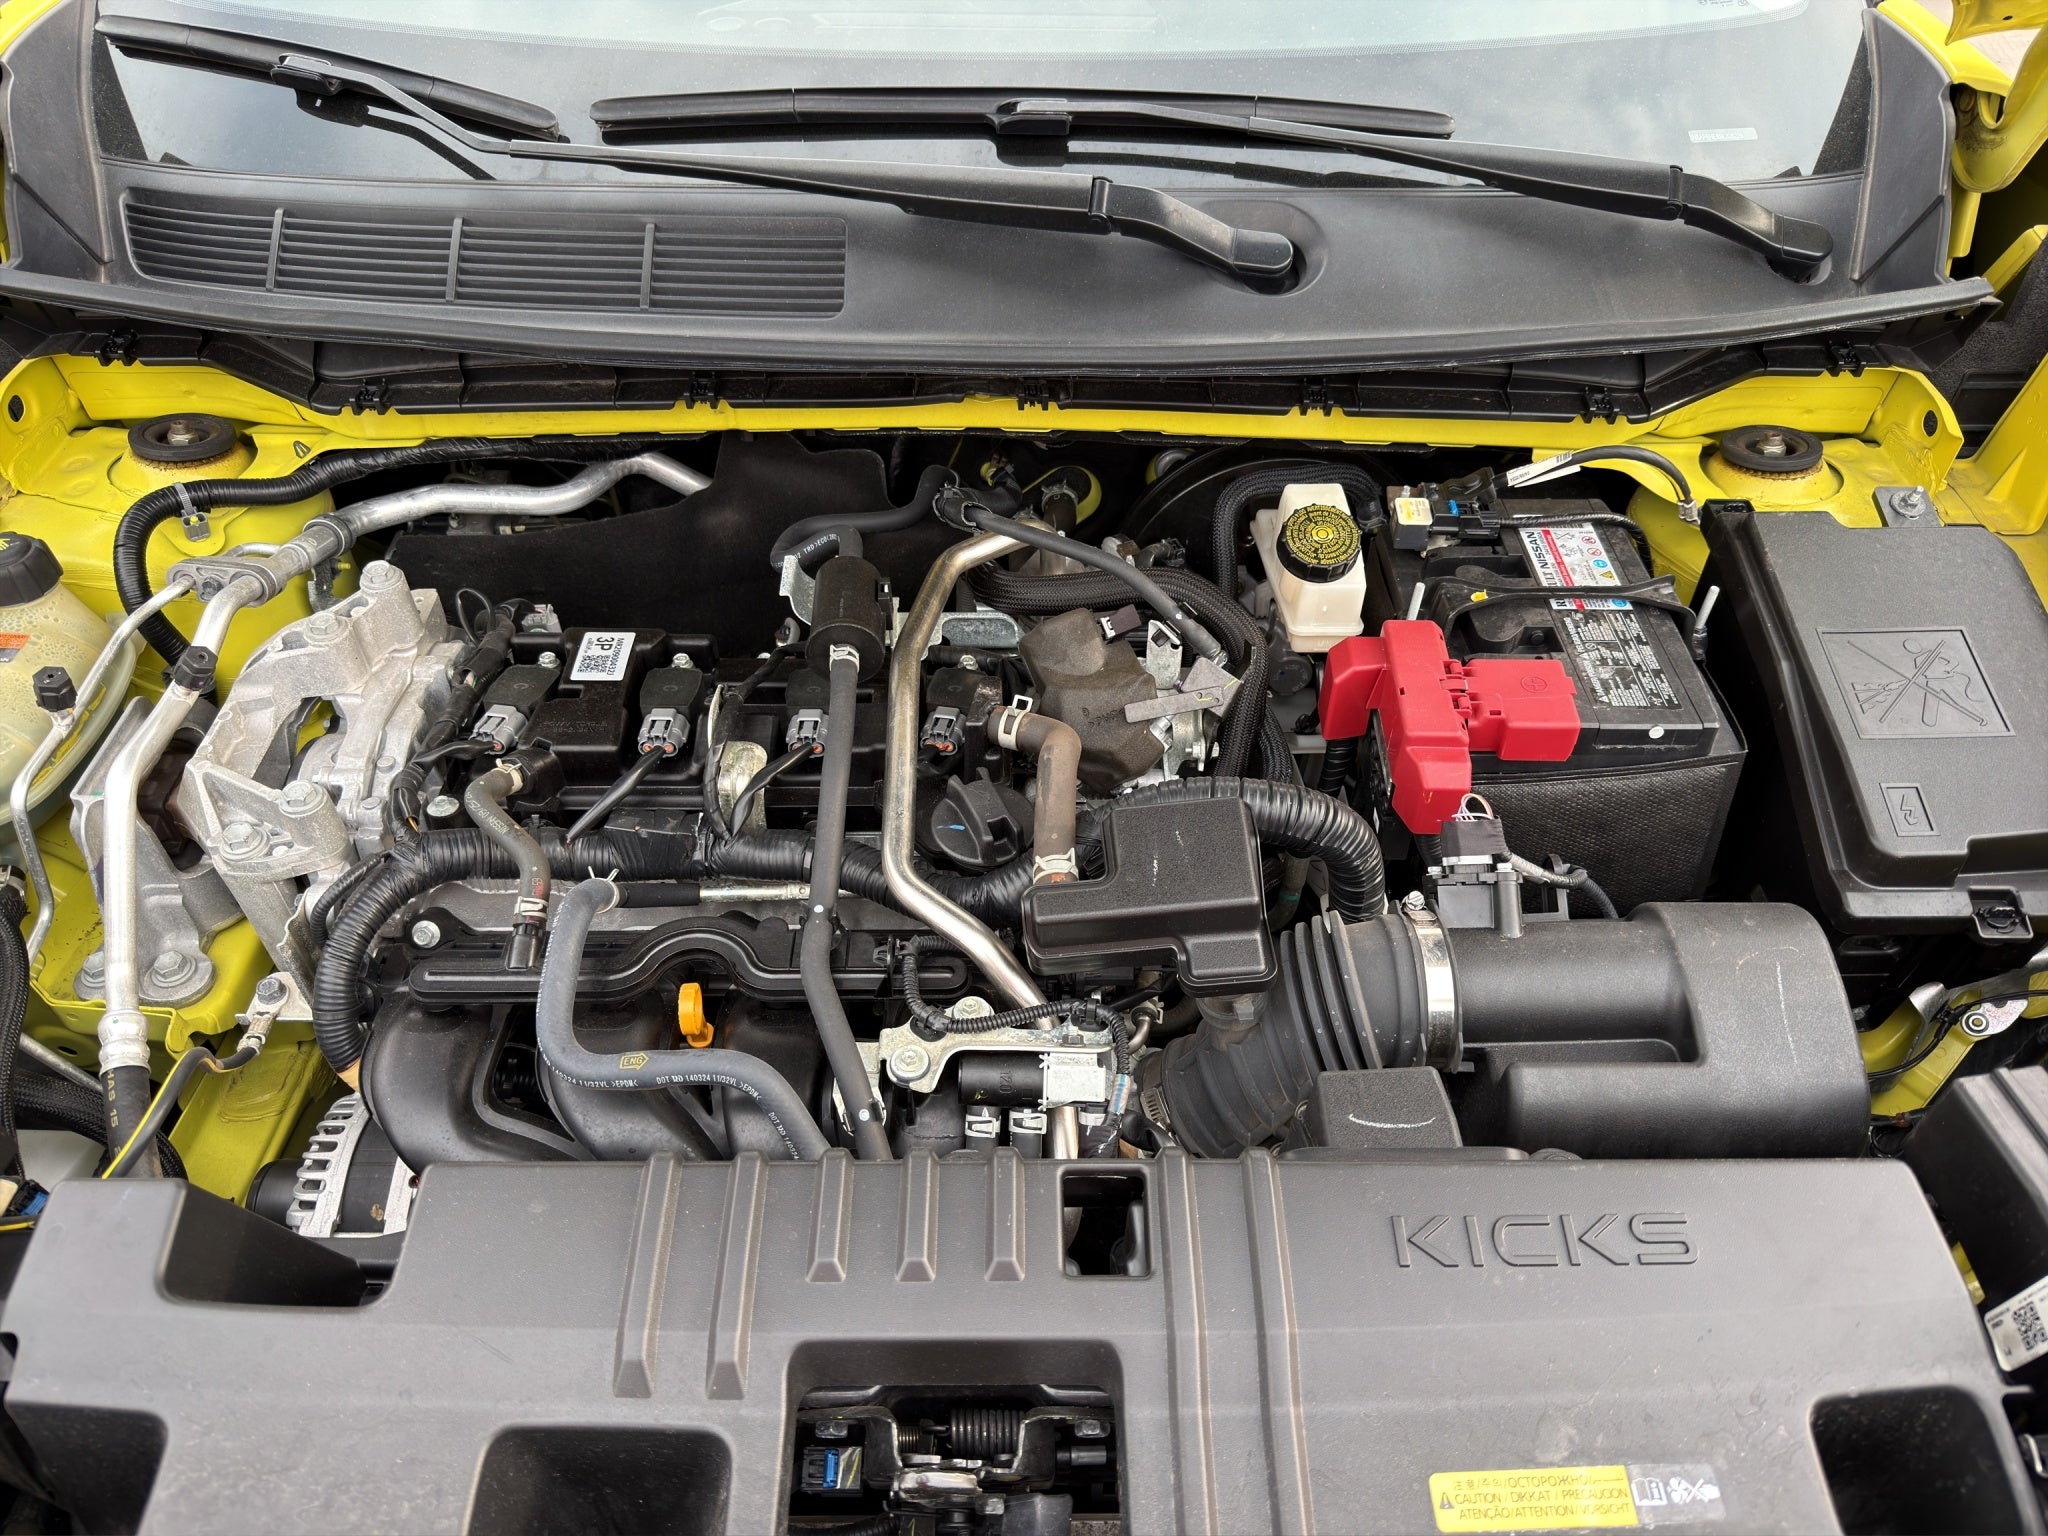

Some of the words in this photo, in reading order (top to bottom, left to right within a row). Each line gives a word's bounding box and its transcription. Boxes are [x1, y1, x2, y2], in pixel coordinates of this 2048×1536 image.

[1525, 531, 1550, 569] NISSAN
[595, 637, 615, 651] 3P
[623, 1056, 643, 1066] ENG
[656, 1076, 670, 1085] DOT
[685, 1074, 711, 1082] 140324
[110, 1109, 119, 1128] 15
[1390, 1211, 1700, 1269] KICKS
[1454, 1492, 1502, 1505] CAUTION
